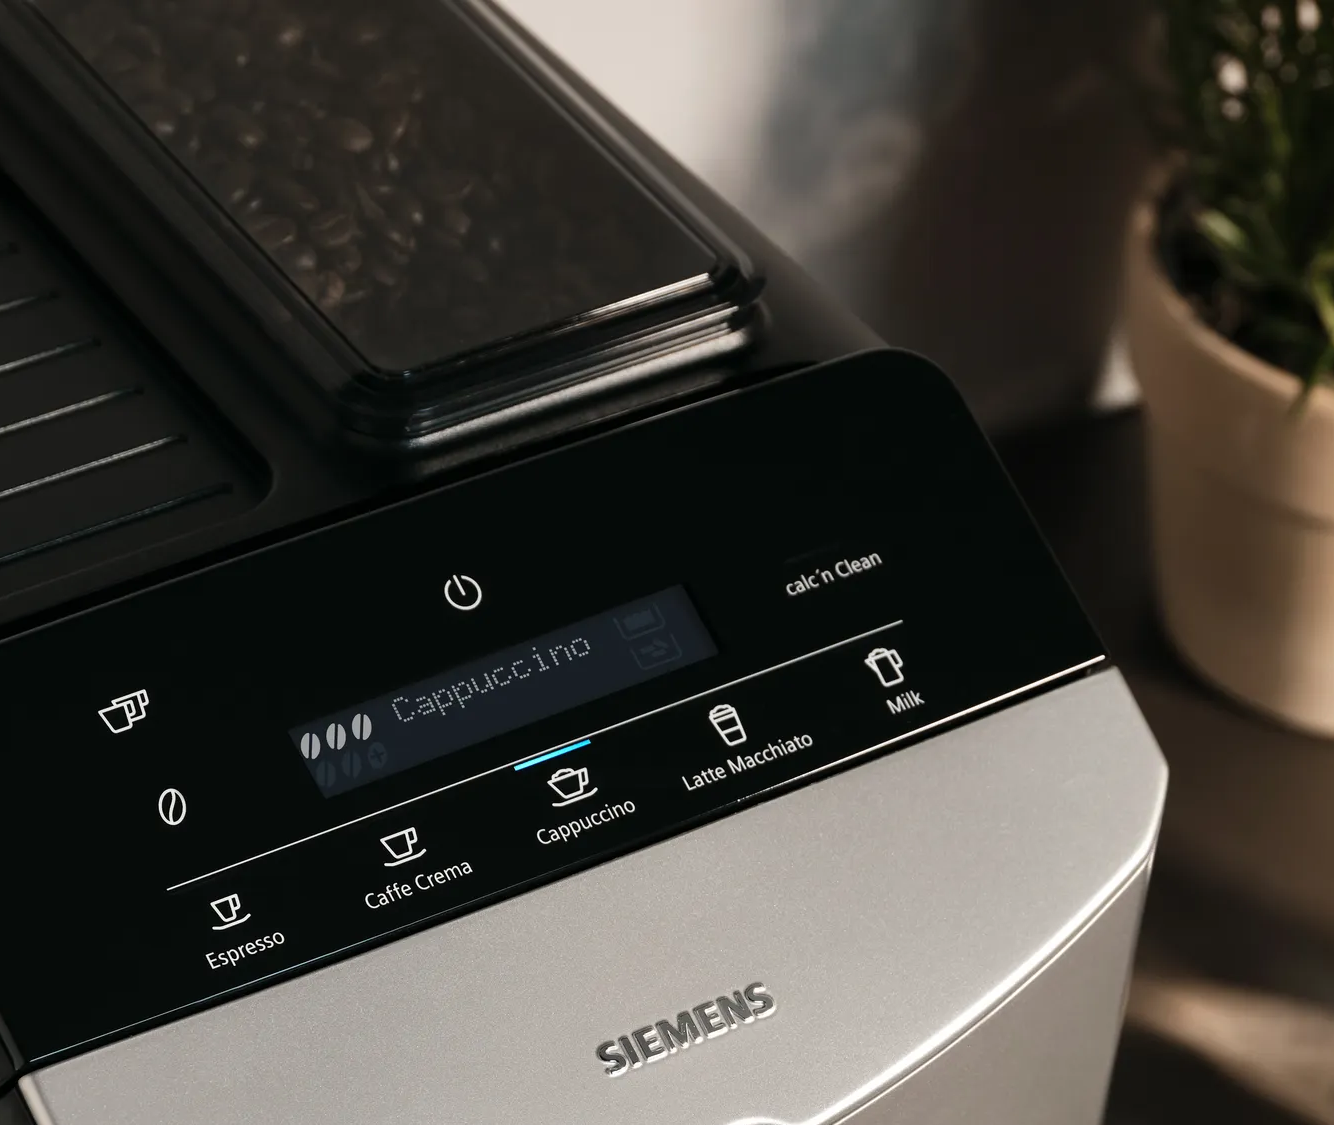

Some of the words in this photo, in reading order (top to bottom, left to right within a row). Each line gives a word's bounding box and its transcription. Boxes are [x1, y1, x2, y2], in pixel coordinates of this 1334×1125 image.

[835, 552, 883, 578] Clean
[391, 637, 591, 723] Cappuccino
[885, 689, 926, 715] Milk
[681, 766, 727, 791] Latte
[726, 733, 814, 775] Macchiato
[536, 800, 636, 845] Cappuccino
[364, 882, 413, 909] Caffe
[414, 861, 474, 891] Crema
[205, 931, 285, 970] Espresso
[596, 981, 776, 1078] SIEMENS
